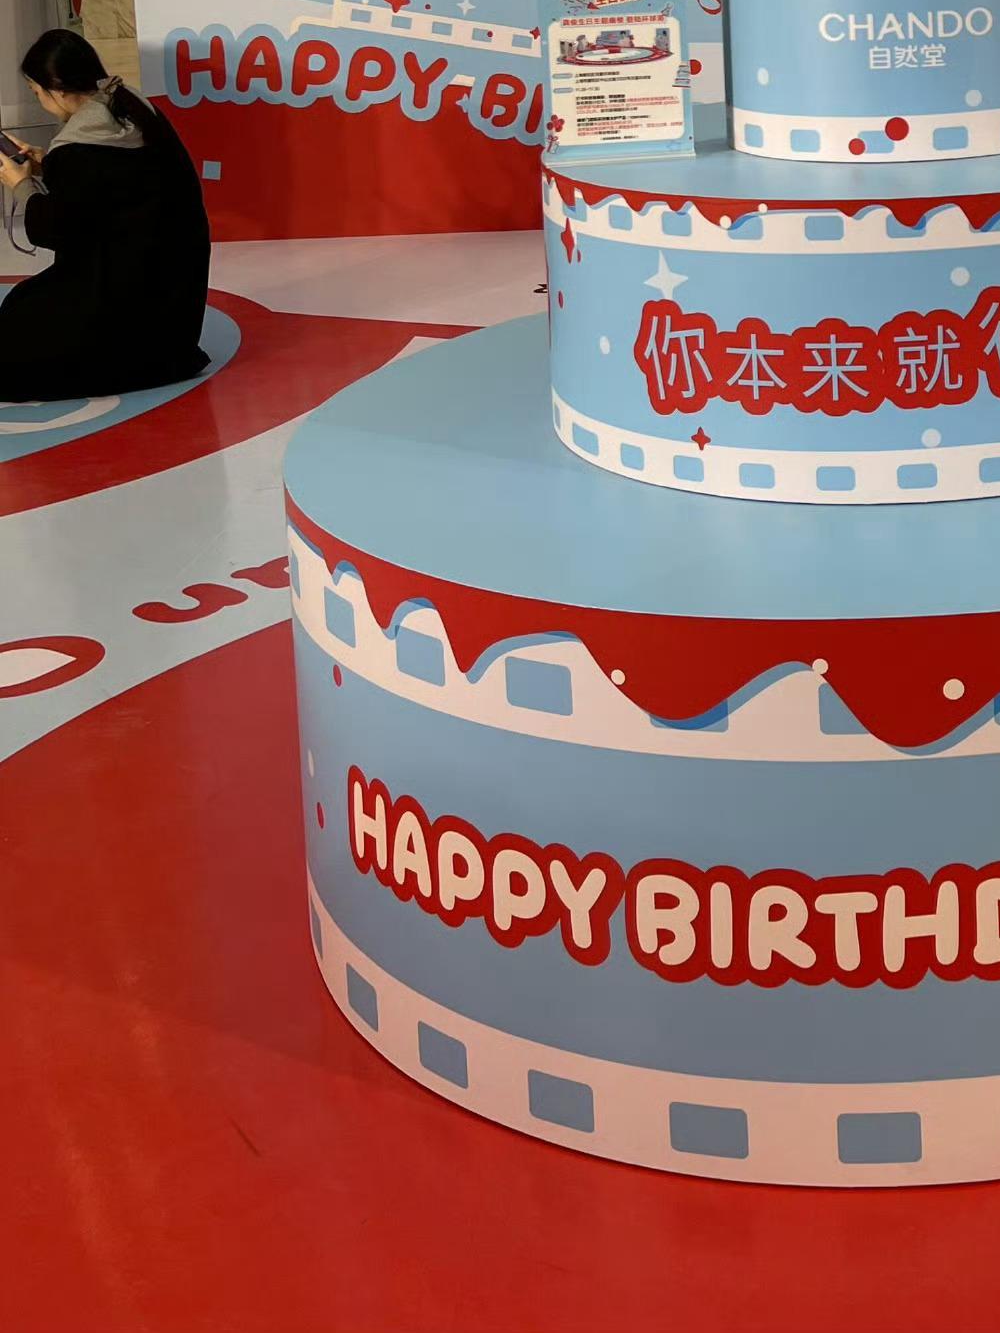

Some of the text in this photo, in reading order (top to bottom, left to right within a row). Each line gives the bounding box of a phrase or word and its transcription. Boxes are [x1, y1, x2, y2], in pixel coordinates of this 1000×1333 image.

[818, 7, 993, 42] CHANDO
[175, 35, 449, 110] HAPPY
[868, 44, 947, 70] 自然堂
[352, 780, 607, 949] HAPPY
